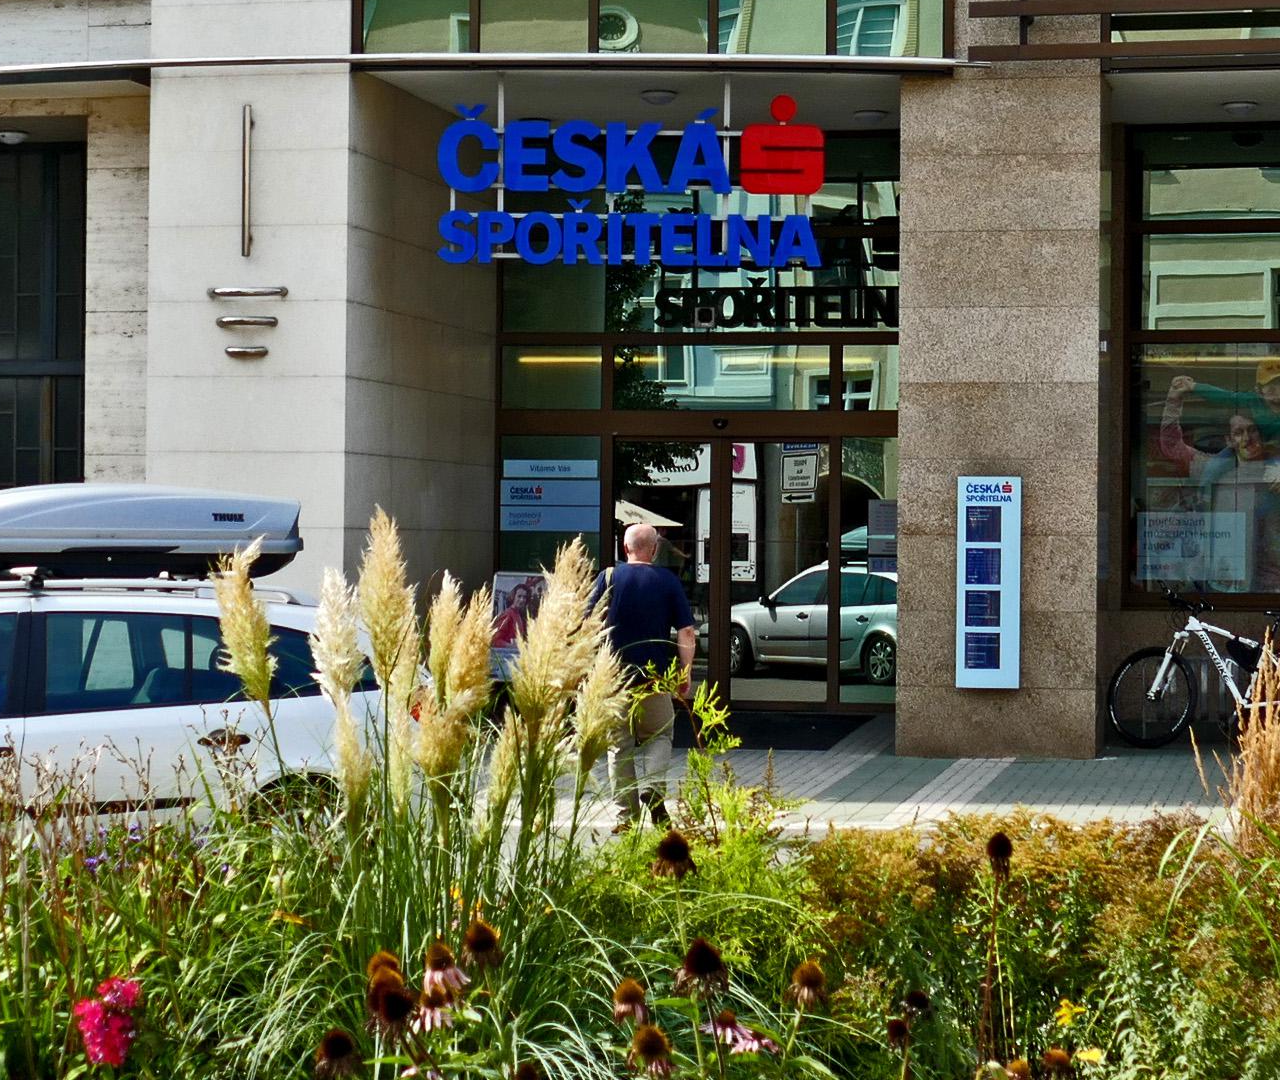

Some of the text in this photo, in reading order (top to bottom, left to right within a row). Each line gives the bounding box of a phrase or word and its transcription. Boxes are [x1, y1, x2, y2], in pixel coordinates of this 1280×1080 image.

[437, 103, 732, 195] ČESKÁ
[437, 199, 822, 268] SPOŘITELNA
[510, 485, 534, 494] ČESKÁ
[966, 482, 1001, 494] ČESKÁ
[965, 493, 1013, 502] SPOŘITELNA
